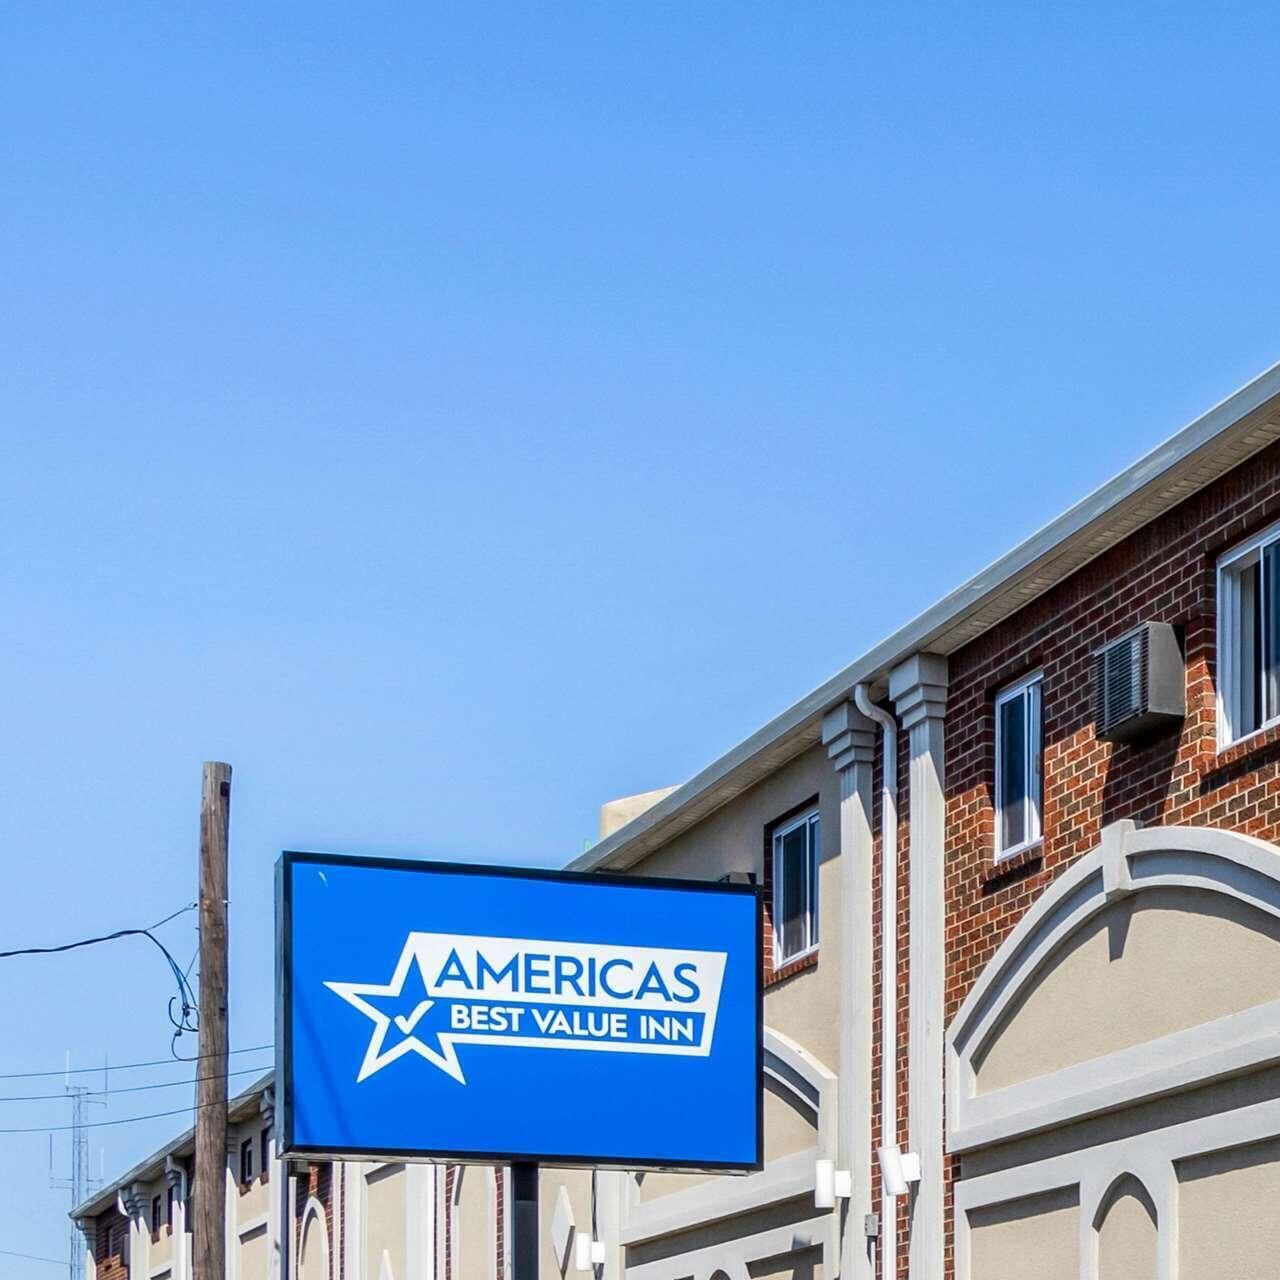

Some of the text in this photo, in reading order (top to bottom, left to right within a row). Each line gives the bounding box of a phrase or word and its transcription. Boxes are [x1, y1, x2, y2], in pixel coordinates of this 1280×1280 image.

[434, 947, 701, 1004] AMERICAS
[450, 1003, 694, 1042] BEST VALUE INN
